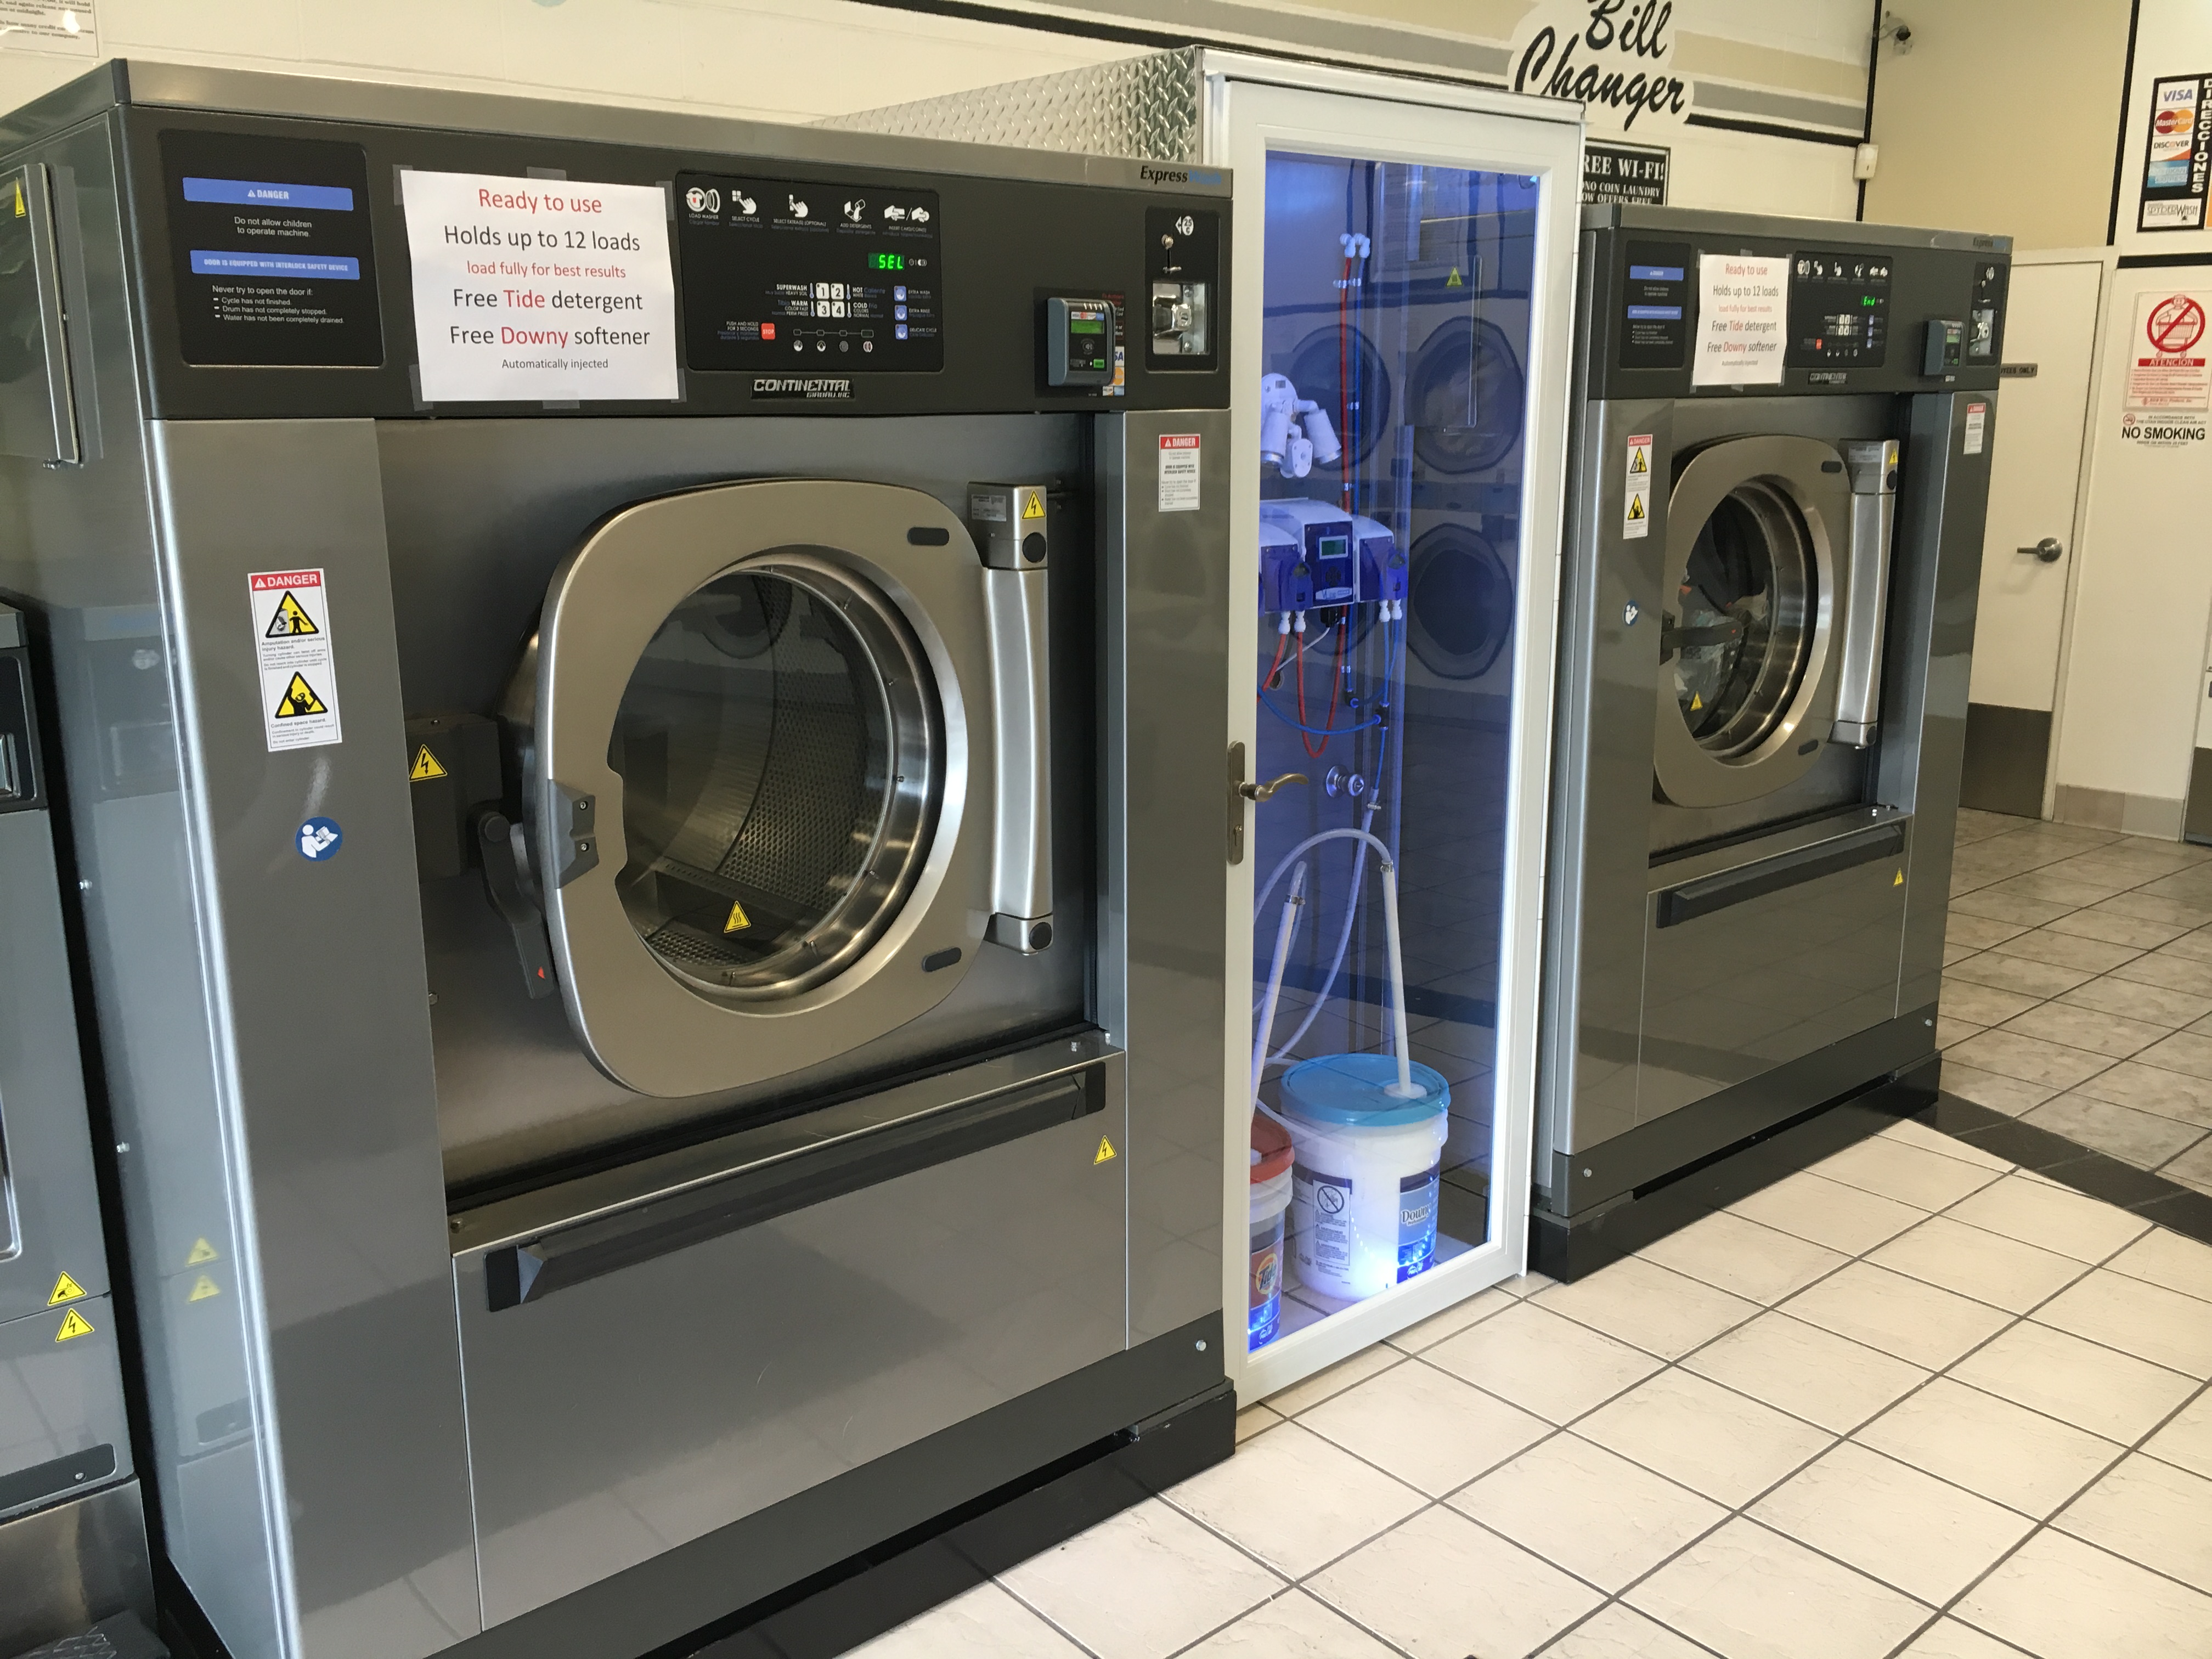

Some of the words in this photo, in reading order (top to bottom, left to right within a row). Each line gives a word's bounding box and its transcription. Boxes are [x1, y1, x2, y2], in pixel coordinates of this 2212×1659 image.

[1586, 0, 1672, 58] Bill
[1515, 26, 1685, 131] Changer
[2164, 89, 2192, 101] VISA
[2155, 117, 2193, 127] MasterCard
[2154, 140, 2189, 149] DISCOVER
[1584, 154, 1611, 175] REE
[1618, 158, 1664, 180] WI-FI!
[257, 189, 289, 199] DANGER
[1582, 181, 1596, 191] NO
[1599, 182, 1620, 193] COIN
[1623, 184, 1660, 198] LAUNDRY
[479, 189, 537, 213] Ready
[544, 194, 563, 211] to
[571, 198, 602, 213] use
[1582, 192, 1595, 202] OW
[283, 219, 312, 228] children
[444, 225, 500, 246] Holds
[509, 232, 531, 251] up
[538, 230, 557, 248] to
[565, 231, 586, 249] 12
[592, 232, 640, 251] loads
[879, 255, 902, 269] SEL
[467, 261, 495, 274] load
[500, 262, 527, 278] fully
[532, 262, 550, 276] for
[554, 263, 580, 277] best
[585, 266, 625, 278] results
[1725, 263, 1745, 276] Ready
[1747, 264, 1755, 274] to
[1757, 266, 1768, 275] use
[821, 287, 825, 296] 1
[836, 288, 840, 297] 2
[1713, 285, 1731, 296] Holds
[1734, 287, 1742, 298] up
[1744, 286, 1752, 296] to
[1753, 286, 1760, 296] 12
[1762, 286, 1779, 297] loads
[454, 289, 498, 307] Free
[503, 290, 545, 308] Tide
[552, 290, 642, 313] detergent
[1864, 296, 1875, 306] End
[837, 306, 841, 314] 4
[1712, 320, 1727, 331] Free
[1729, 320, 1743, 331] Tide
[1745, 321, 1776, 333] detergent
[450, 326, 494, 343] Free
[501, 326, 568, 348] Downy
[574, 326, 650, 345] softener
[1707, 342, 1722, 352] Free
[1724, 342, 1747, 353] Downy
[1748, 341, 1777, 352] softener
[502, 358, 568, 370] Automatically
[571, 358, 608, 370] injected
[754, 379, 850, 391] CONTINENTAL
[2122, 427, 2140, 439] NO
[2144, 427, 2205, 440] SMOKING
[1173, 438, 1195, 447] DANGER
[267, 574, 317, 588] DANGER
[1402, 1203, 1431, 1223] Downy
[1259, 1262, 1277, 1290] Tide
